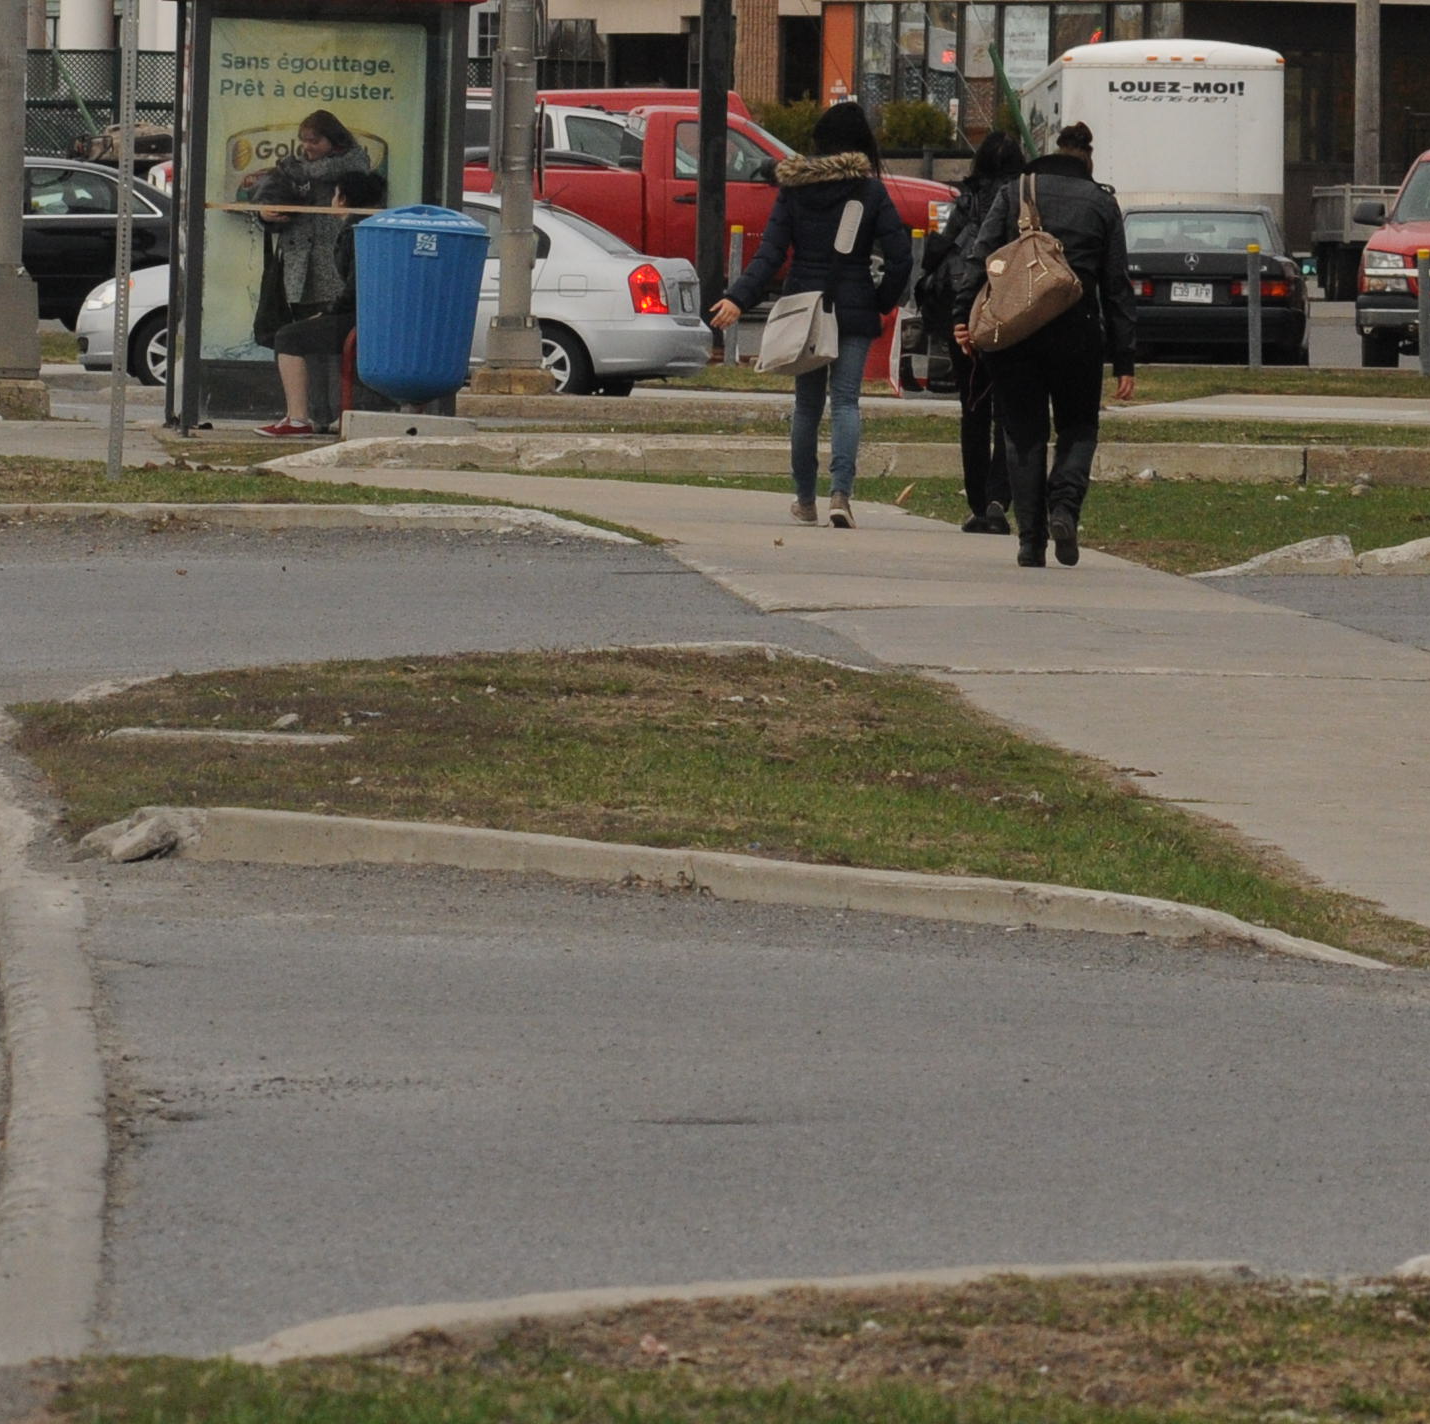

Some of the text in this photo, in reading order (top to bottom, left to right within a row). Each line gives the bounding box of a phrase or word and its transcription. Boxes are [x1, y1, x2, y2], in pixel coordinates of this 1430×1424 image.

[221, 52, 395, 76] Sans égouttage.
[220, 78, 395, 102] Prêt à déguster.
[1108, 80, 1245, 96] LOUEZ-MOI!
